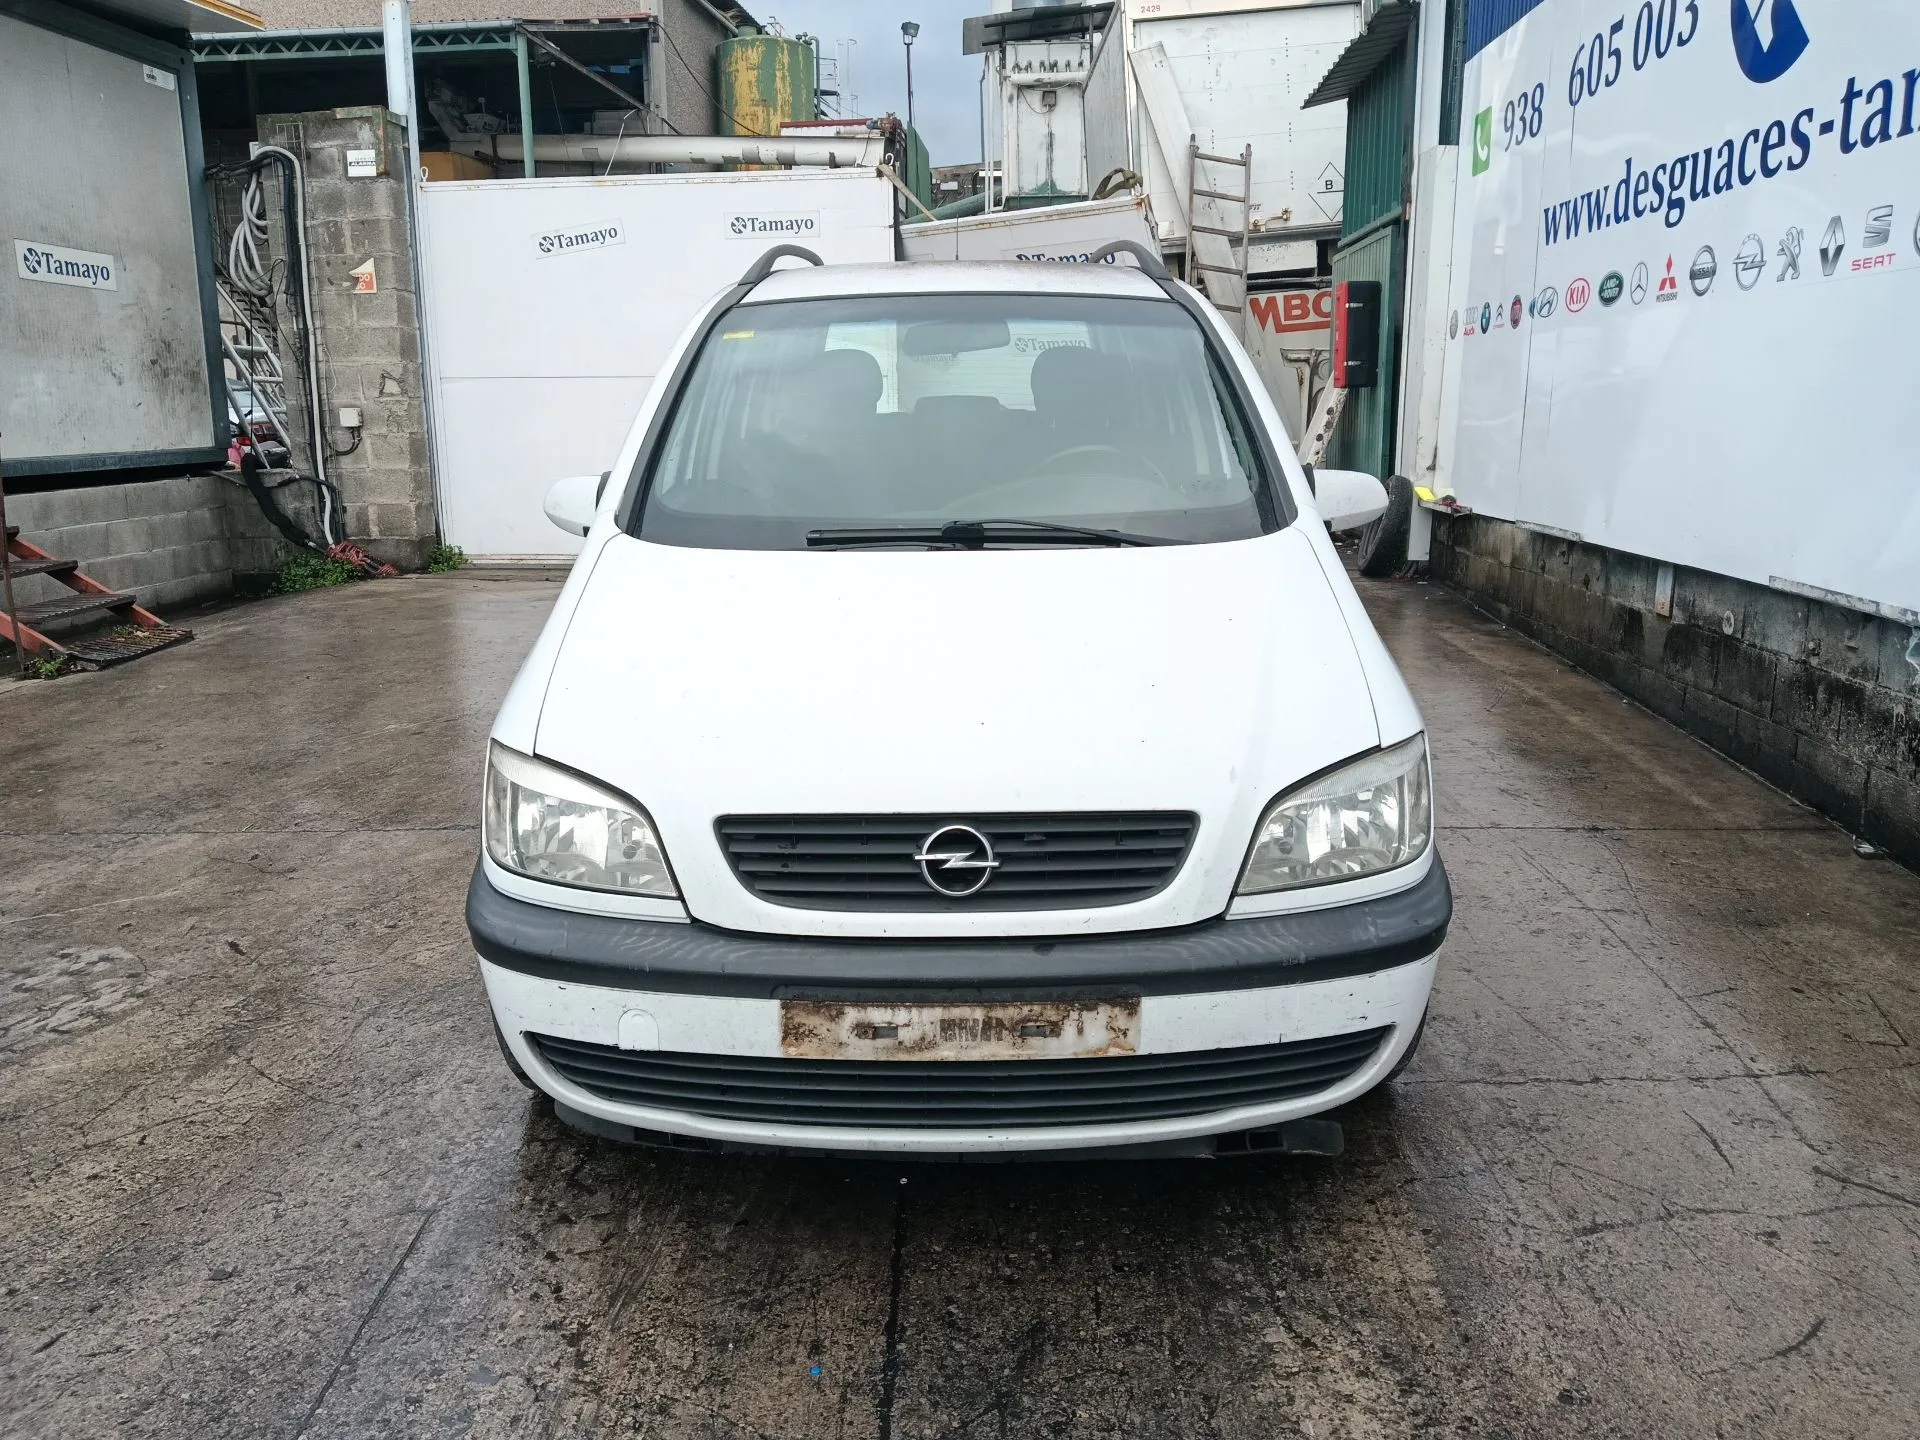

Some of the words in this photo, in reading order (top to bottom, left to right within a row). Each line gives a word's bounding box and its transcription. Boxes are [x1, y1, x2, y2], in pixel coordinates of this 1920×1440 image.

[1140, 4, 1161, 13] 2429
[1503, 82, 1545, 153] 938
[1568, 14, 1625, 107] 605
[1633, 0, 1699, 71] 003
[1325, 179, 1334, 191] B
[747, 217, 814, 234] Tamayo
[553, 227, 618, 249] Tamayo
[41, 252, 110, 285] Tamayo
[1851, 253, 1897, 271] SEAT
[1569, 285, 1586, 306] KIA
